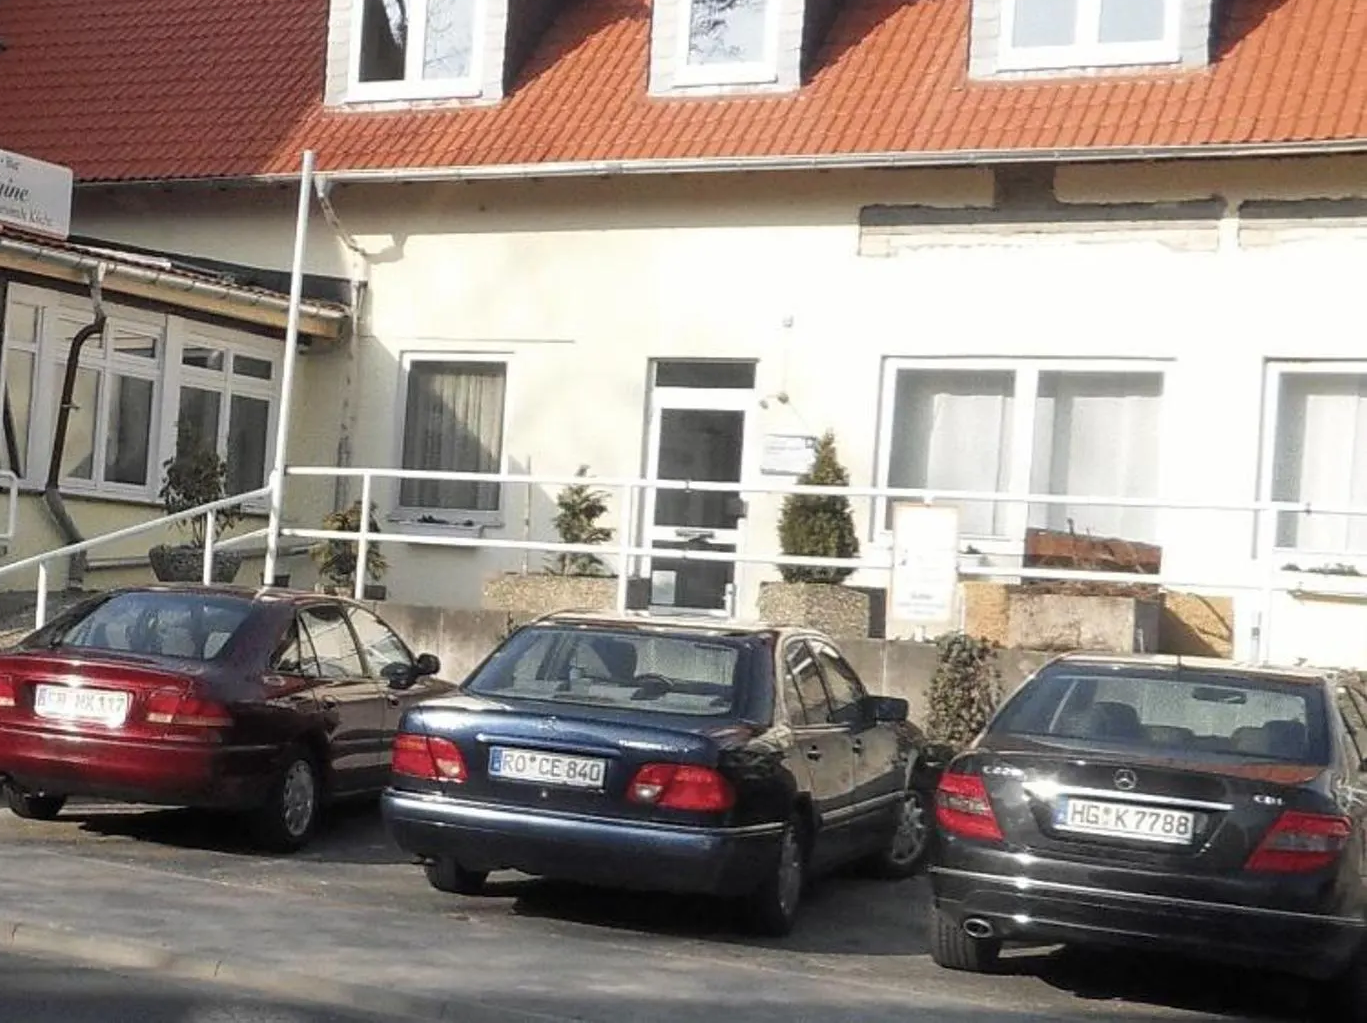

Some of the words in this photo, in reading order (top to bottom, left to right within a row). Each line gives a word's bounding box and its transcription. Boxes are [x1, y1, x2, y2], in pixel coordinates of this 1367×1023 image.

[566, 760, 601, 782] 840
[1070, 803, 1100, 825] HG
[1134, 810, 1190, 835] 7788
